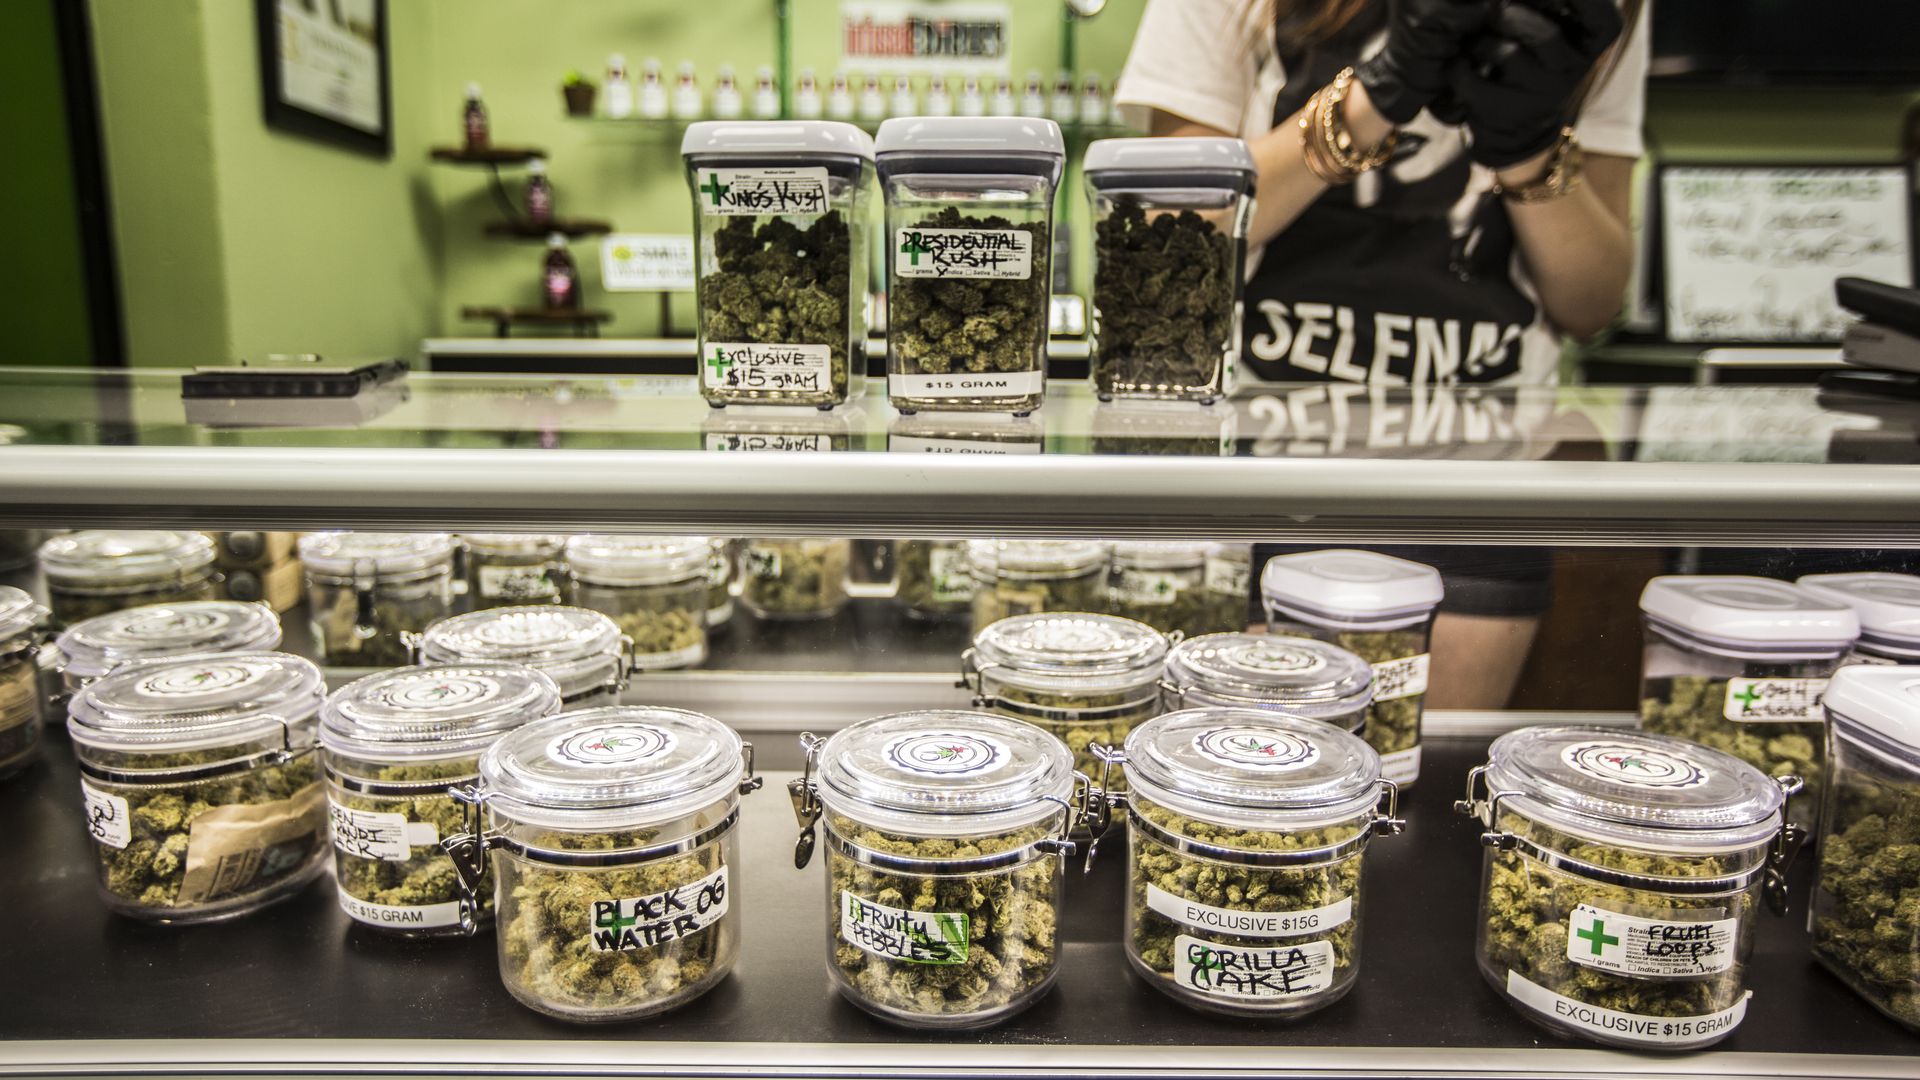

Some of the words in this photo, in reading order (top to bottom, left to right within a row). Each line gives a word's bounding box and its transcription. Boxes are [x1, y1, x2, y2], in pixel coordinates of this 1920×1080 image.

[902, 232, 1026, 252] PRESIDENTIAL
[932, 249, 1008, 270] KUSH
[727, 368, 766, 386] $15
[594, 889, 687, 927] BLACK
[697, 875, 725, 914] OG
[360, 906, 379, 920] $15
[381, 910, 424, 922] GRAM
[1187, 906, 1277, 931] EXCLUSIVE
[1281, 915, 1319, 931] $15G
[594, 914, 700, 950] WATER
[1648, 924, 1713, 940] FRUIT
[1188, 943, 1308, 971] GORILLA
[1597, 959, 1620, 968] grams
[1191, 964, 1311, 995] CAKE
[1555, 1000, 1659, 1035] EXCLUSIVE
[1663, 1023, 1692, 1036] $15
[1696, 1013, 1733, 1035] GRAM
